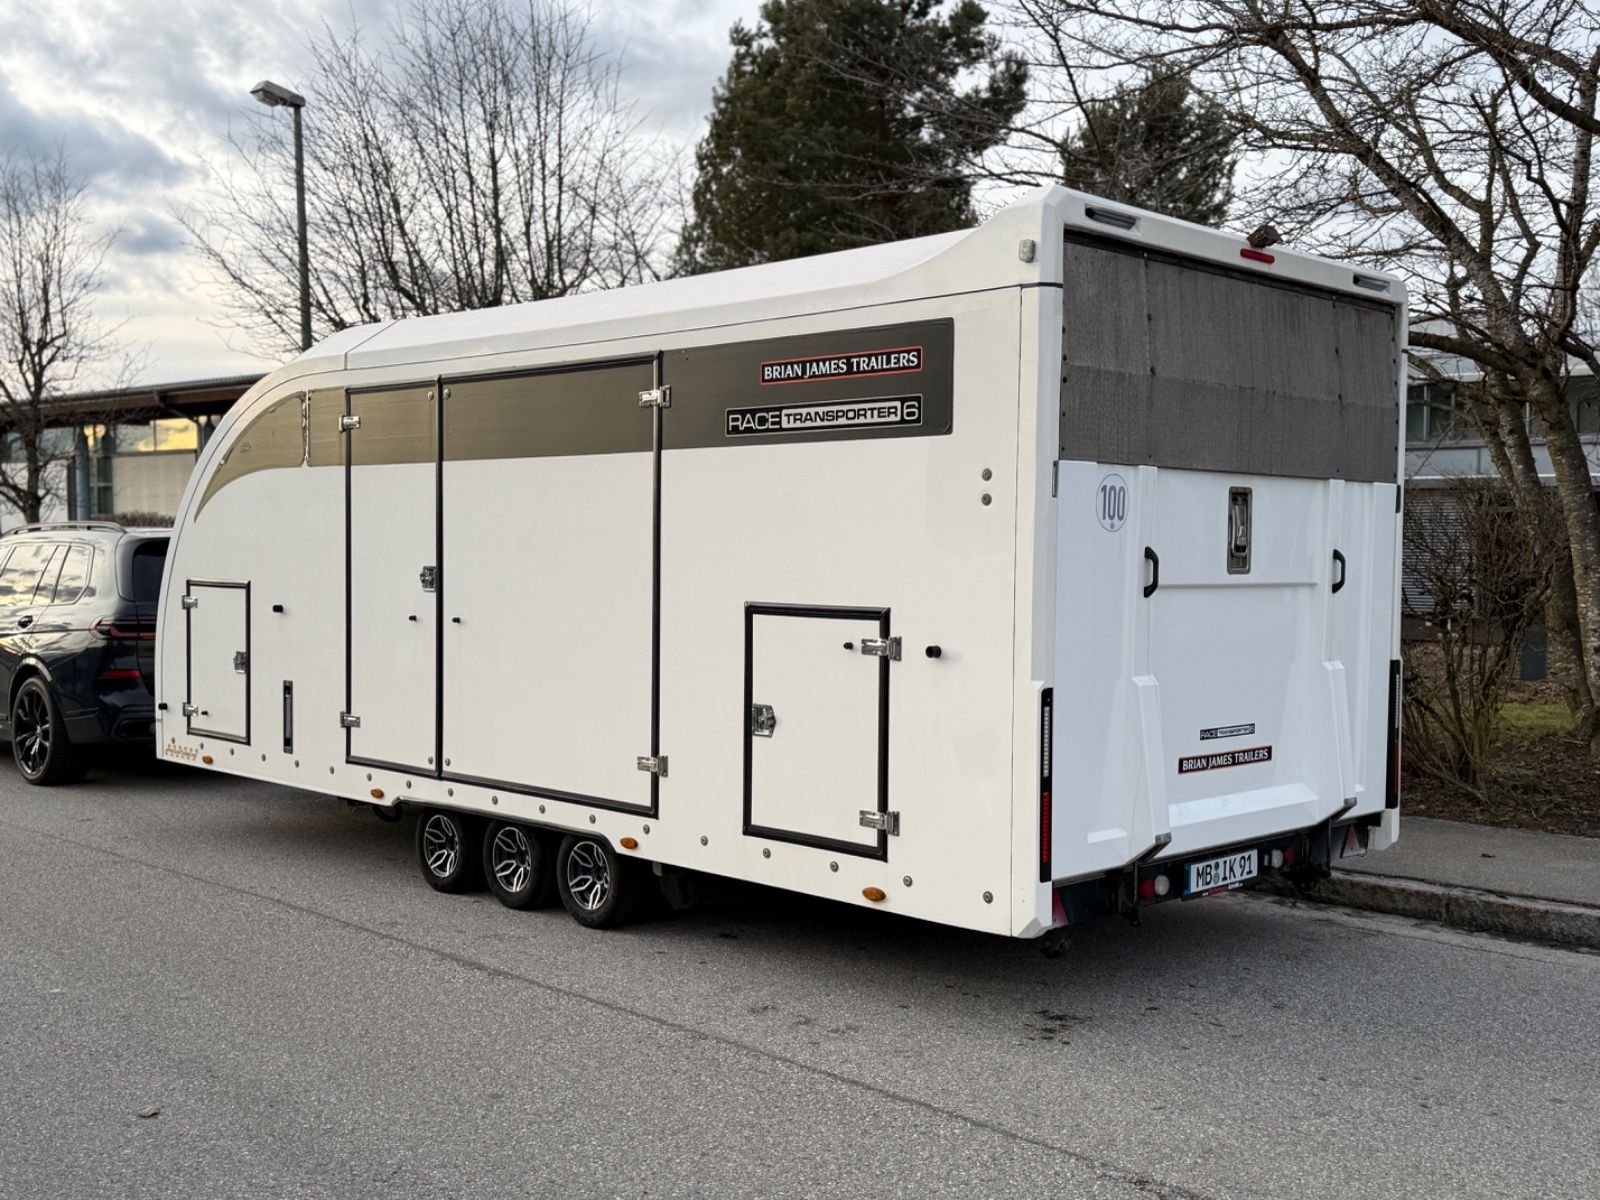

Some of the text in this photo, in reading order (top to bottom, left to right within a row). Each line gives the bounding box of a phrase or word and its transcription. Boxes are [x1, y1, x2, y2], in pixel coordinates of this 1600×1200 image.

[764, 352, 918, 380] BRIAN JAMES TRAILERS
[729, 401, 919, 431] RACE TRANSPORTER 6
[1101, 485, 1126, 521] 100
[1182, 749, 1269, 771] BRIAN JAMES TRAILERS
[1196, 854, 1252, 888] MB IK 91
